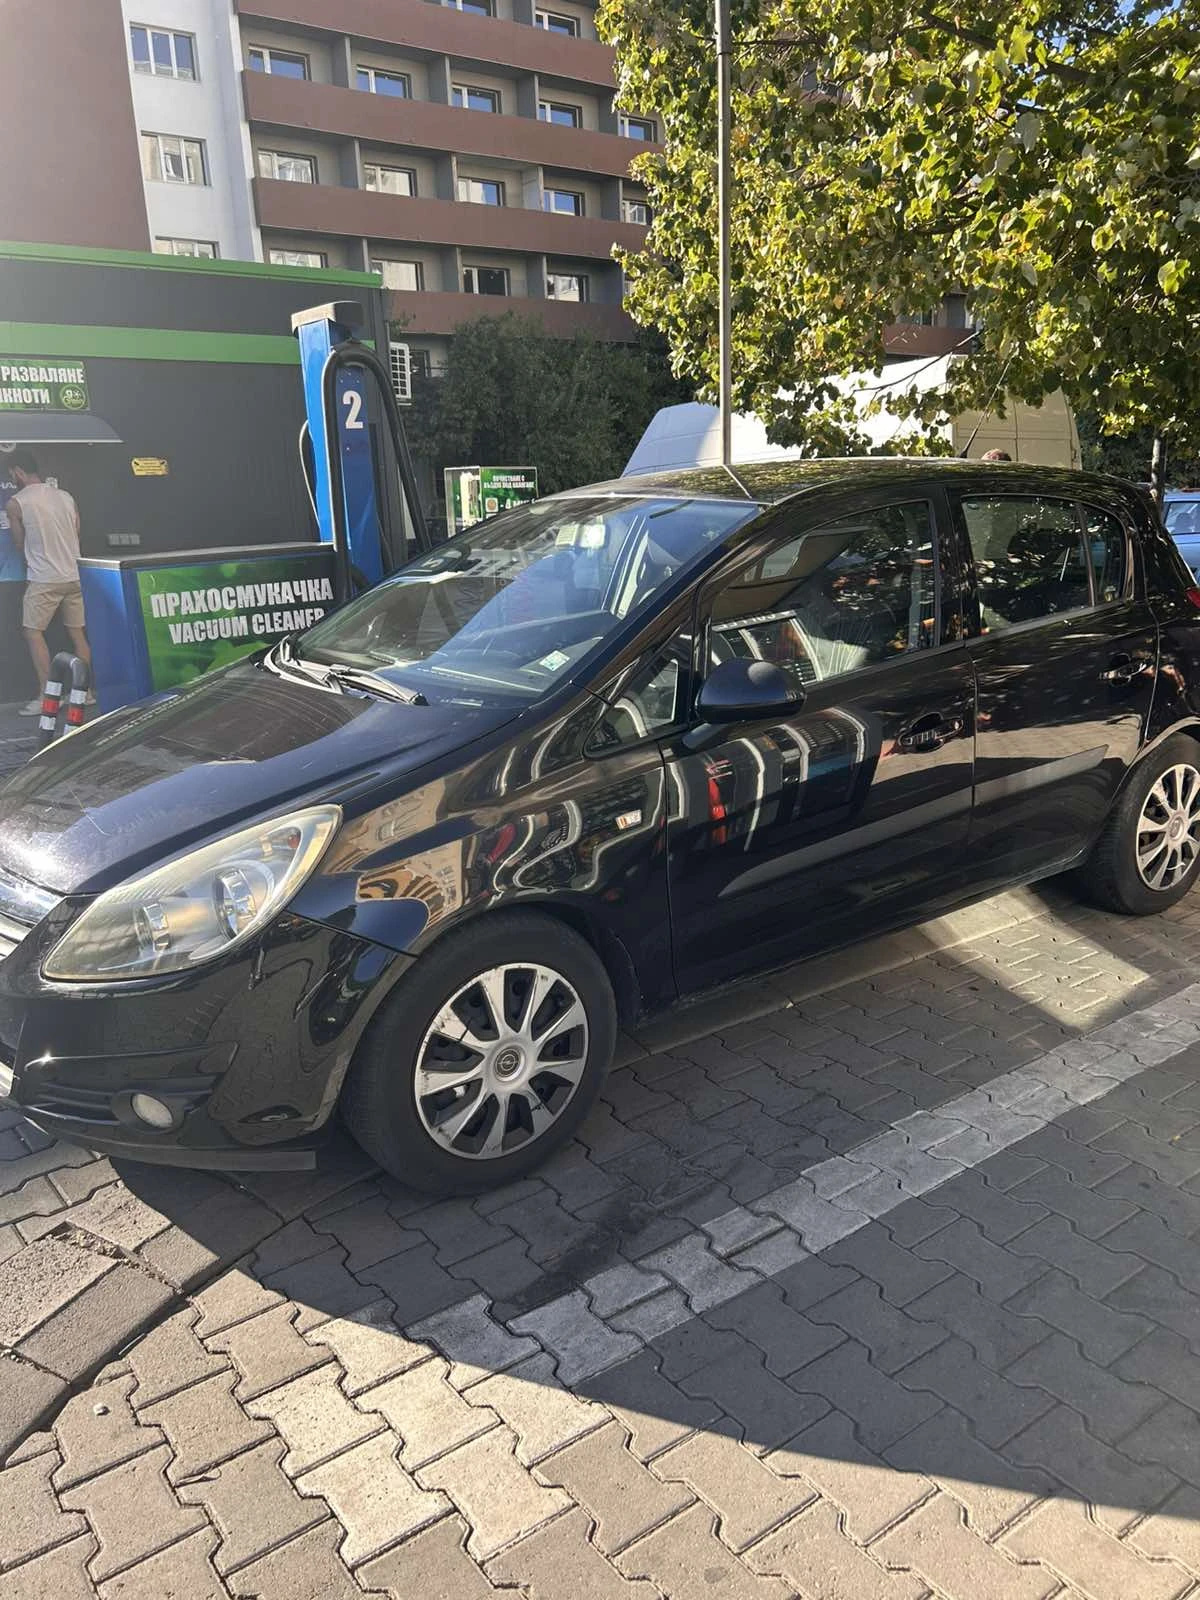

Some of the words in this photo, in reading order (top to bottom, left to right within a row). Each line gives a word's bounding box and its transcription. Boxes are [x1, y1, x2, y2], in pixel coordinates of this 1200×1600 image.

[1, 366, 84, 383] РАЗВАЛЯНЕ
[343, 390, 364, 429] 2
[150, 578, 333, 618] ПРАХОСМУКАЧКА
[168, 615, 249, 645] VACUUM
